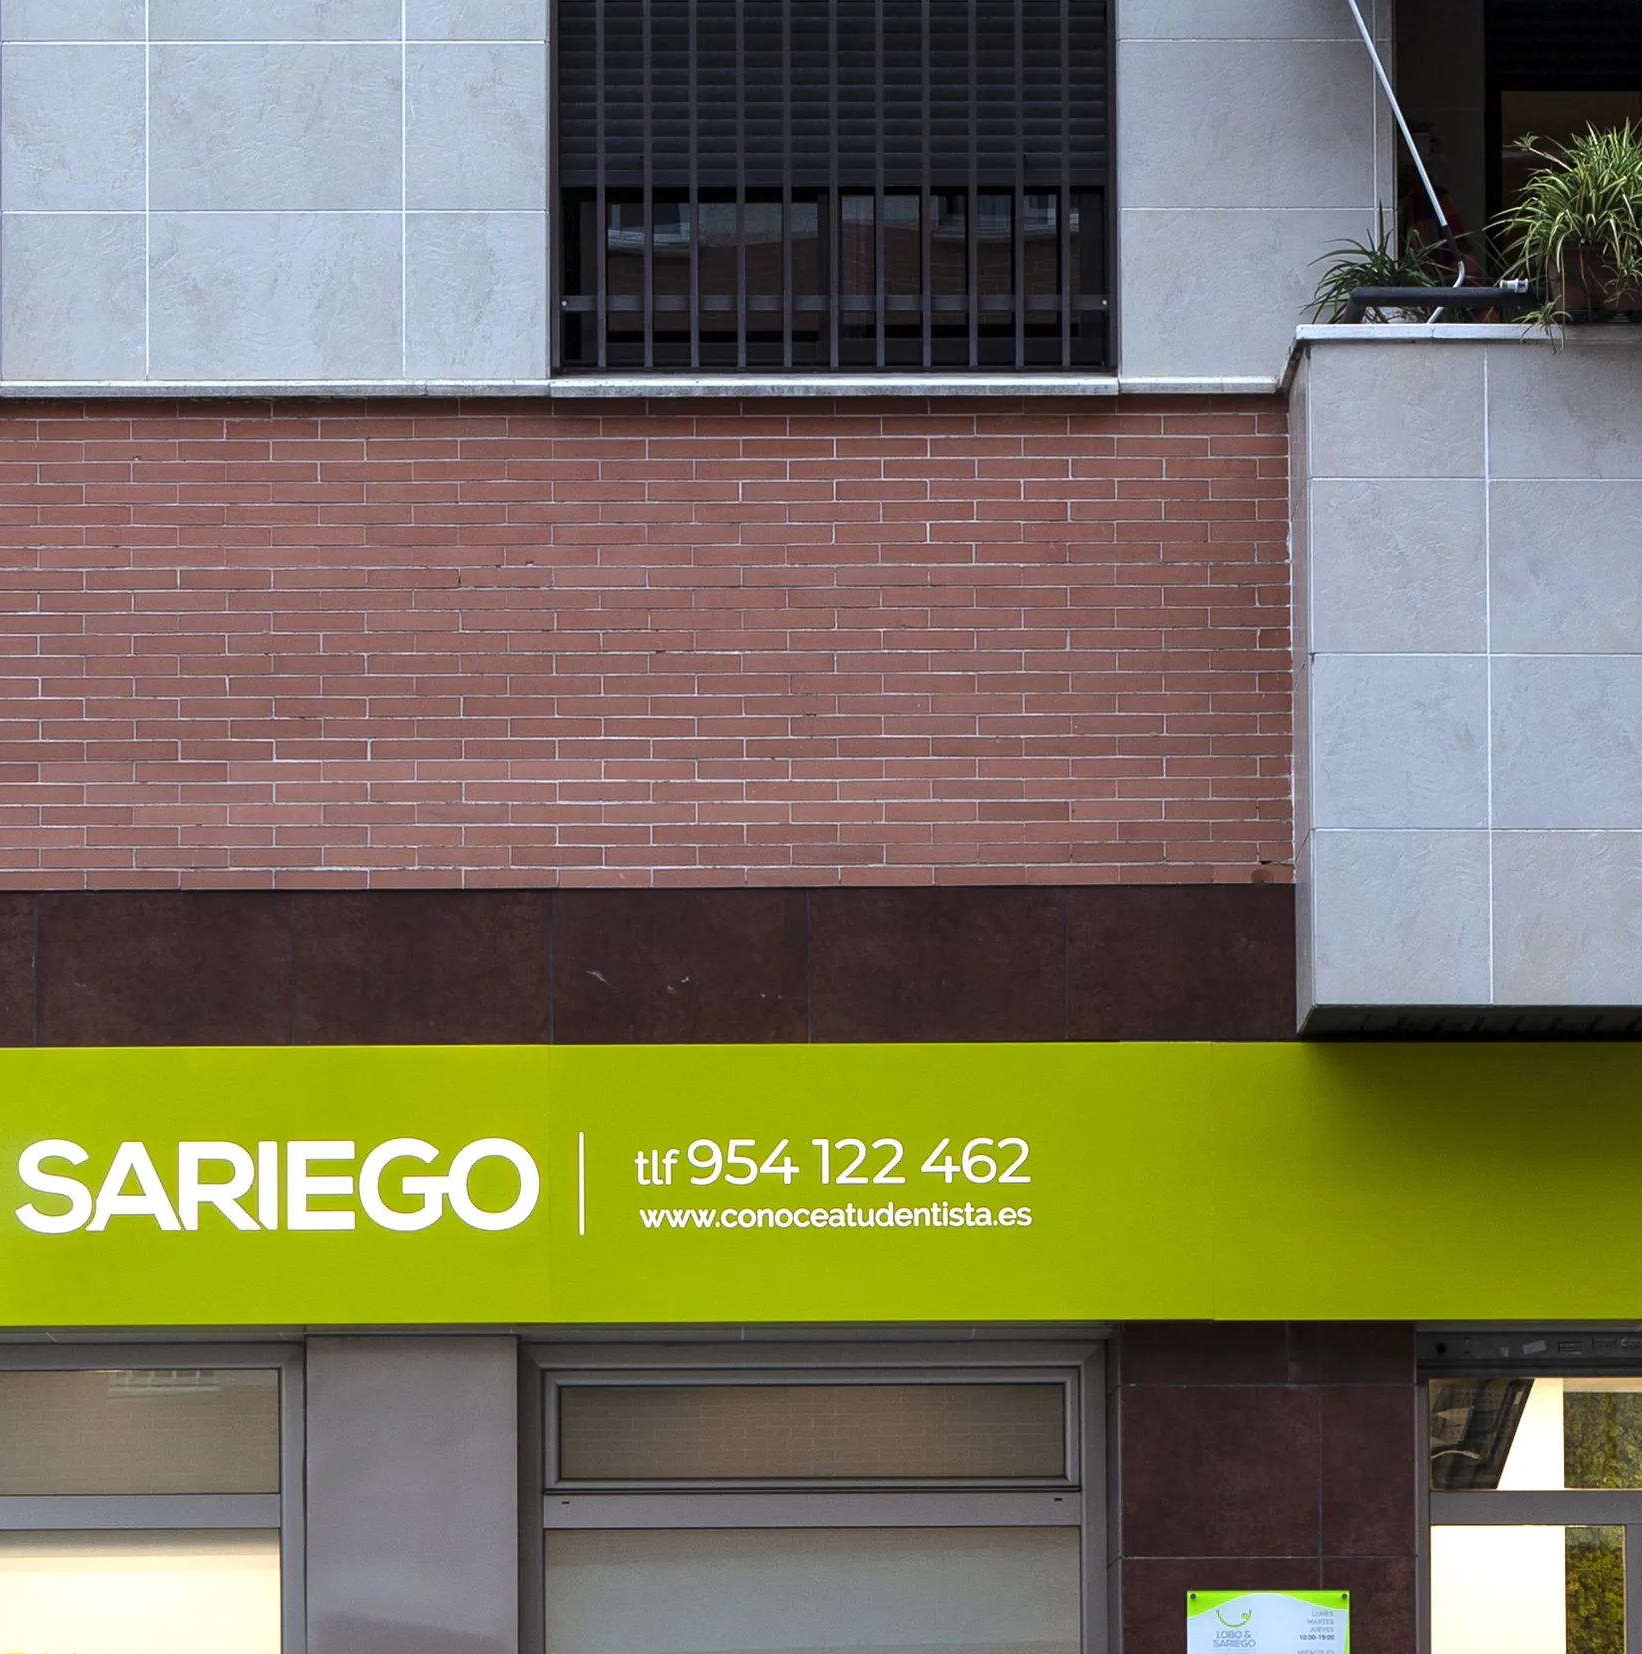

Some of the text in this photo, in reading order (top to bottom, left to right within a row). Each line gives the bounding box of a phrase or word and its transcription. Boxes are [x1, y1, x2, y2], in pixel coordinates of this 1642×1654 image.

[634, 1138, 1032, 1186] tlf 954 122 462
[15, 1138, 541, 1236] SARIEGO
[640, 1201, 1033, 1229] www.conoceatudentista.es
[1212, 1639, 1257, 1648] SARIEGO
[1216, 1630, 1252, 1639] LOBO &
